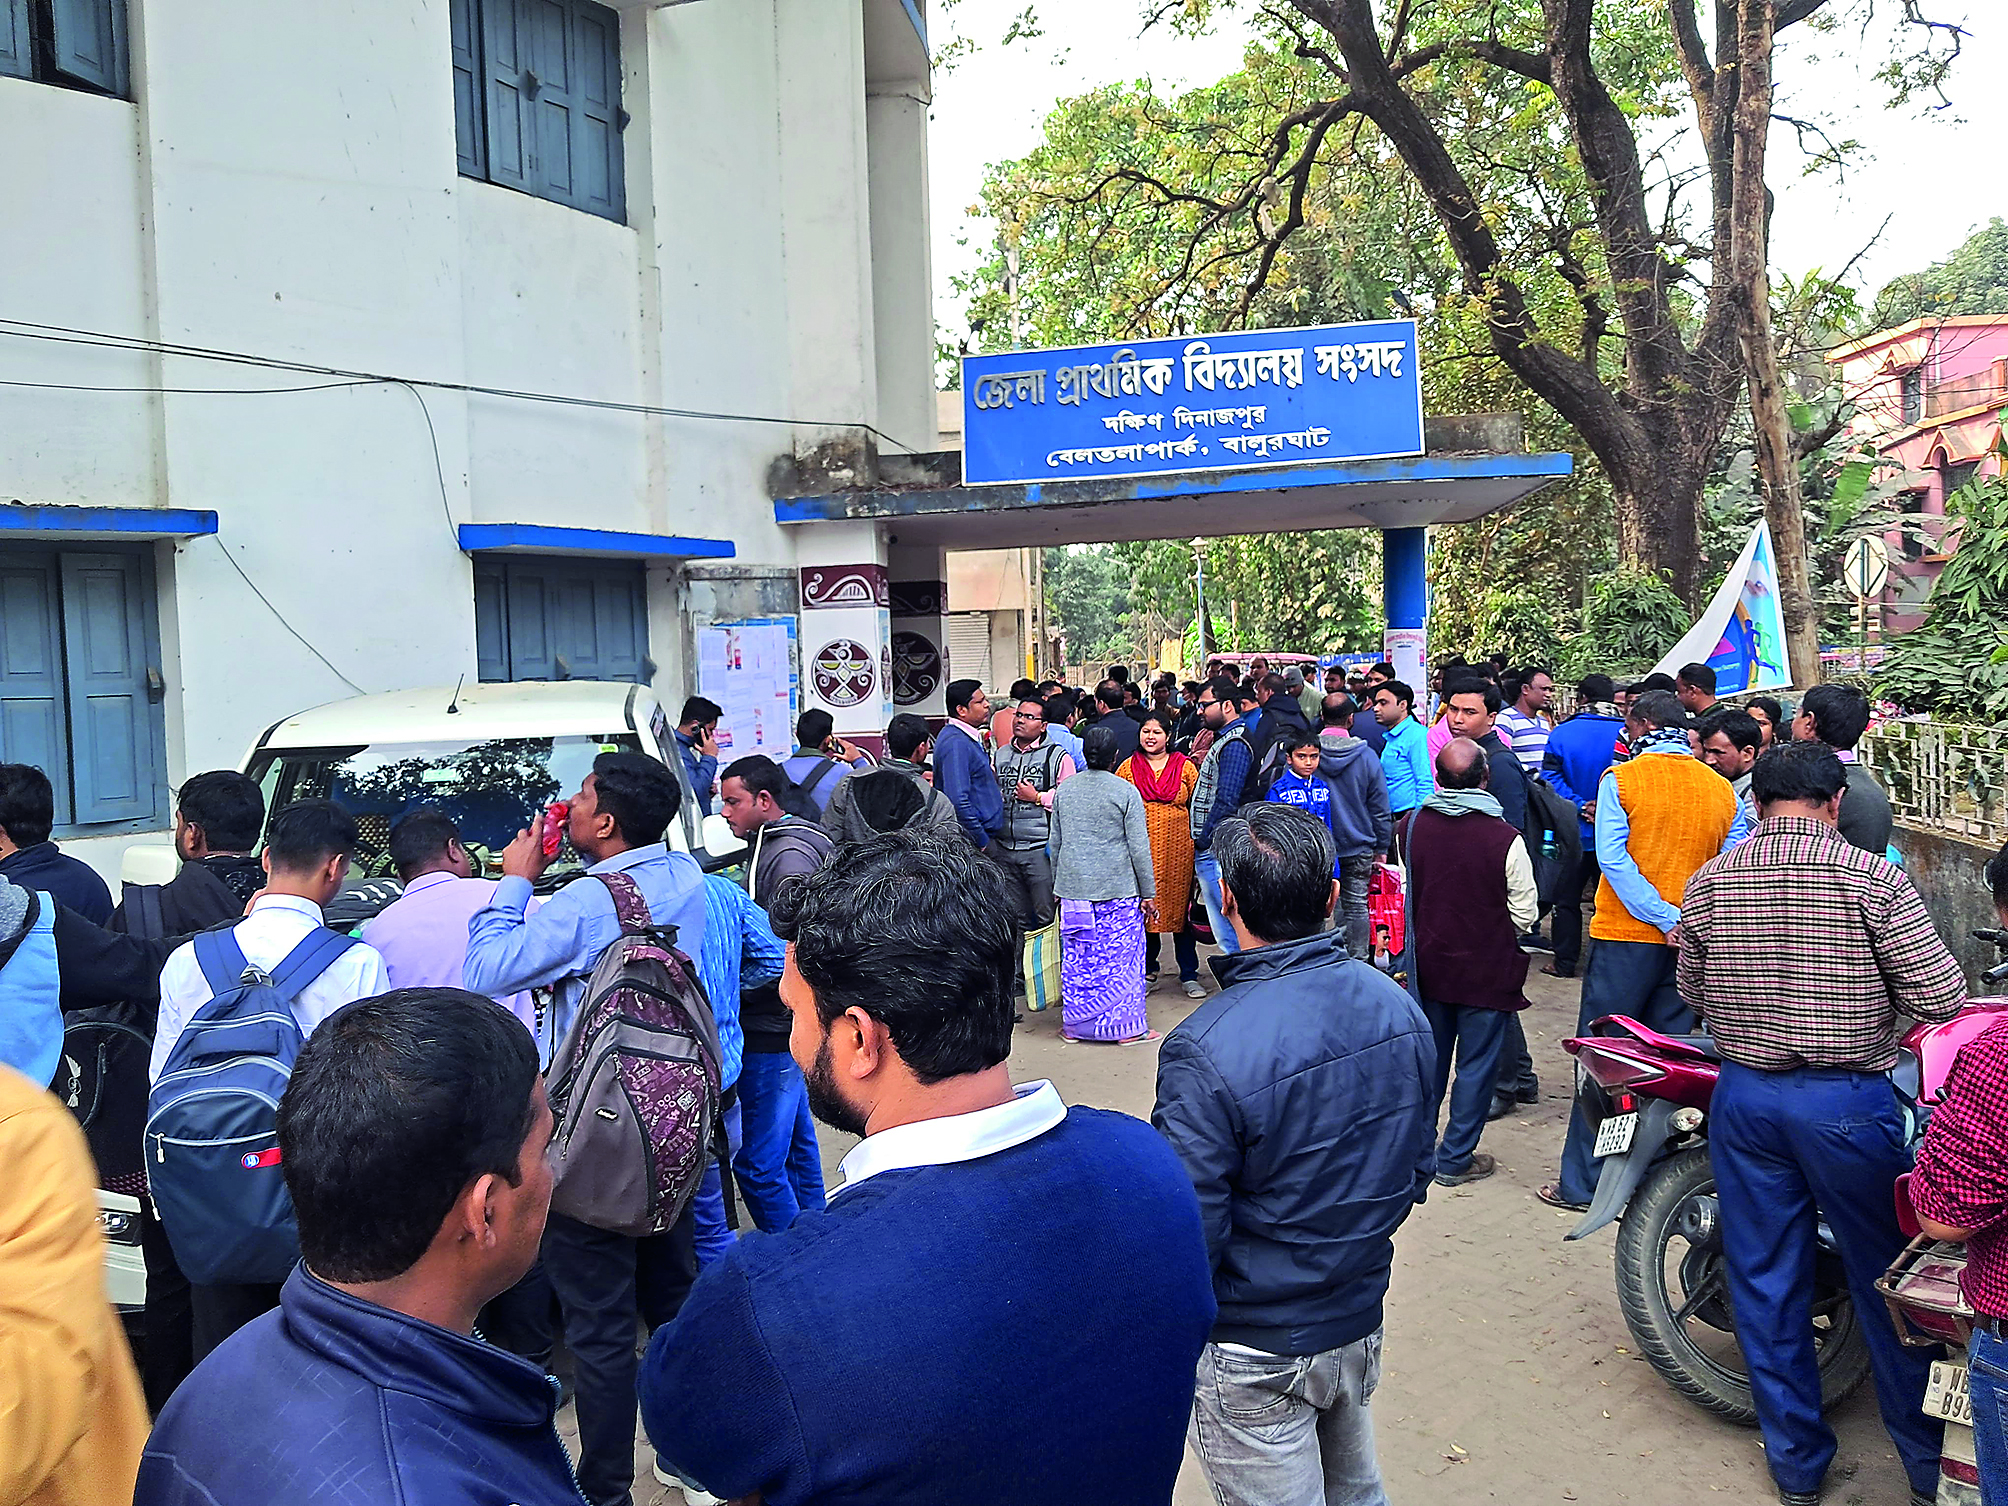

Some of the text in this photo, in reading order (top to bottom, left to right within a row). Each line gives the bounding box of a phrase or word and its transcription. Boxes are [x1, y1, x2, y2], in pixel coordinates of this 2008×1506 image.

[973, 340, 1407, 409] জেলা প্রাথমিক বিদ্যালয় সংসদ
[1102, 404, 1267, 434] দক্ষিণ দিনাজপুর
[1218, 425, 1332, 457] বালুরঘাট
